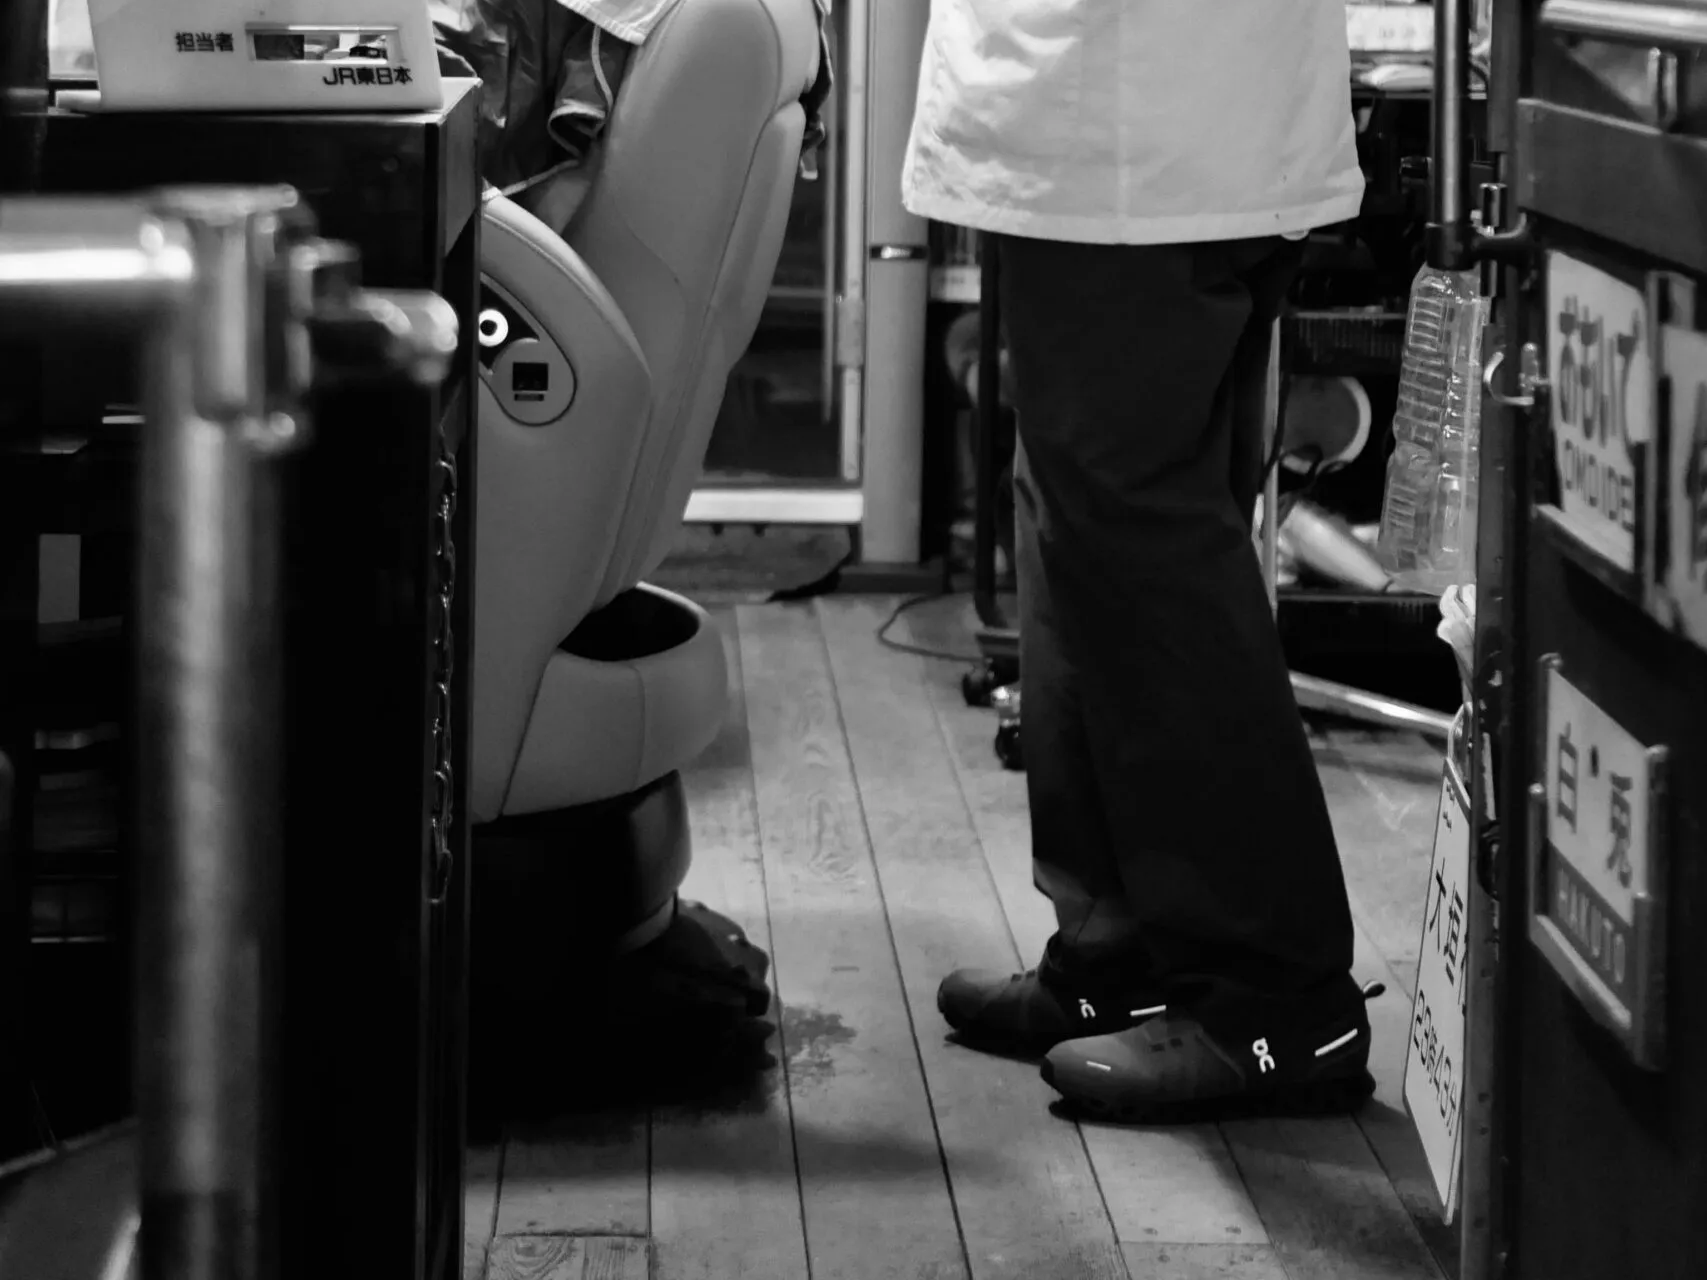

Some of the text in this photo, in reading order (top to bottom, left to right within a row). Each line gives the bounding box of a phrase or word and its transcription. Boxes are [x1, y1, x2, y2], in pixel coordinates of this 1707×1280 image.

[175, 32, 234, 53] 担当者
[323, 67, 412, 86] JR東日本
